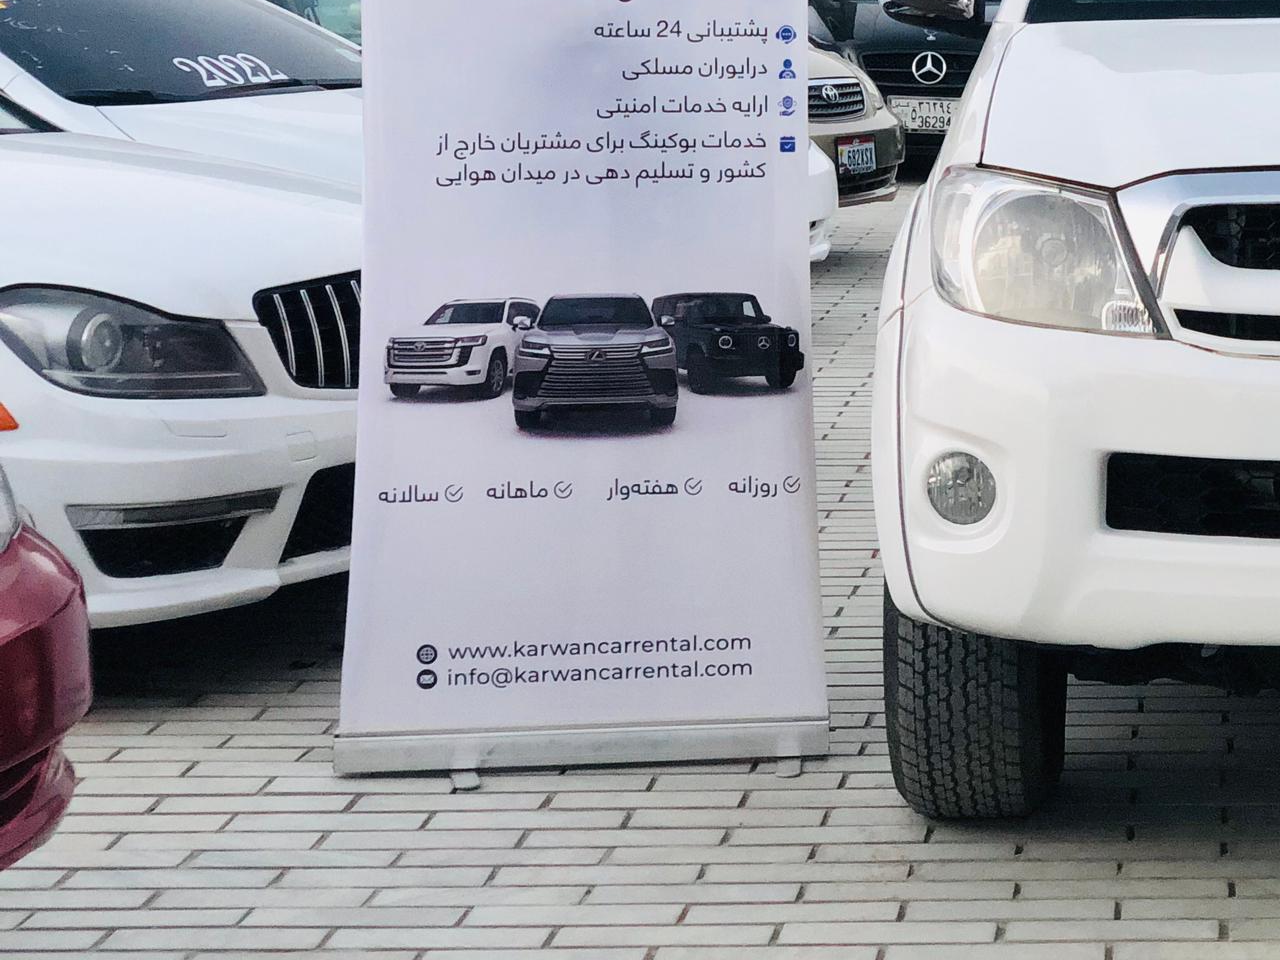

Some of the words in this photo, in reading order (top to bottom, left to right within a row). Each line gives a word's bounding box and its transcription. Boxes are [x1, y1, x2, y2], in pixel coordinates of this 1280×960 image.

[594, 20, 651, 38] ساعته
[656, 21, 682, 38] 24
[687, 19, 768, 44] پشتیبانی
[173, 53, 289, 87] 2022
[622, 59, 693, 80] مسلکی
[698, 57, 768, 79] درایوران
[596, 95, 656, 118] امنیتی
[661, 96, 726, 113] خدمات
[732, 95, 768, 114] ارایه
[436, 133, 448, 155] از
[453, 133, 496, 159] خارج
[500, 131, 581, 154] مشتریان
[586, 131, 625, 154] برای
[629, 130, 696, 154] بوکینگ
[698, 130, 767, 149] خدمات
[435, 164, 496, 187] هوایی
[501, 163, 556, 183] میدان
[562, 167, 581, 185] در
[585, 167, 630, 186] دهی
[635, 164, 694, 188] تسلیم
[699, 168, 710, 184] و
[716, 161, 766, 183] کشور
[378, 483, 439, 504] سالانه
[486, 480, 549, 500] ماهانه
[728, 475, 778, 498] روزانه
[448, 635, 751, 660] www.karwancarrental.com
[447, 660, 753, 688] info@karwancarrental.com
